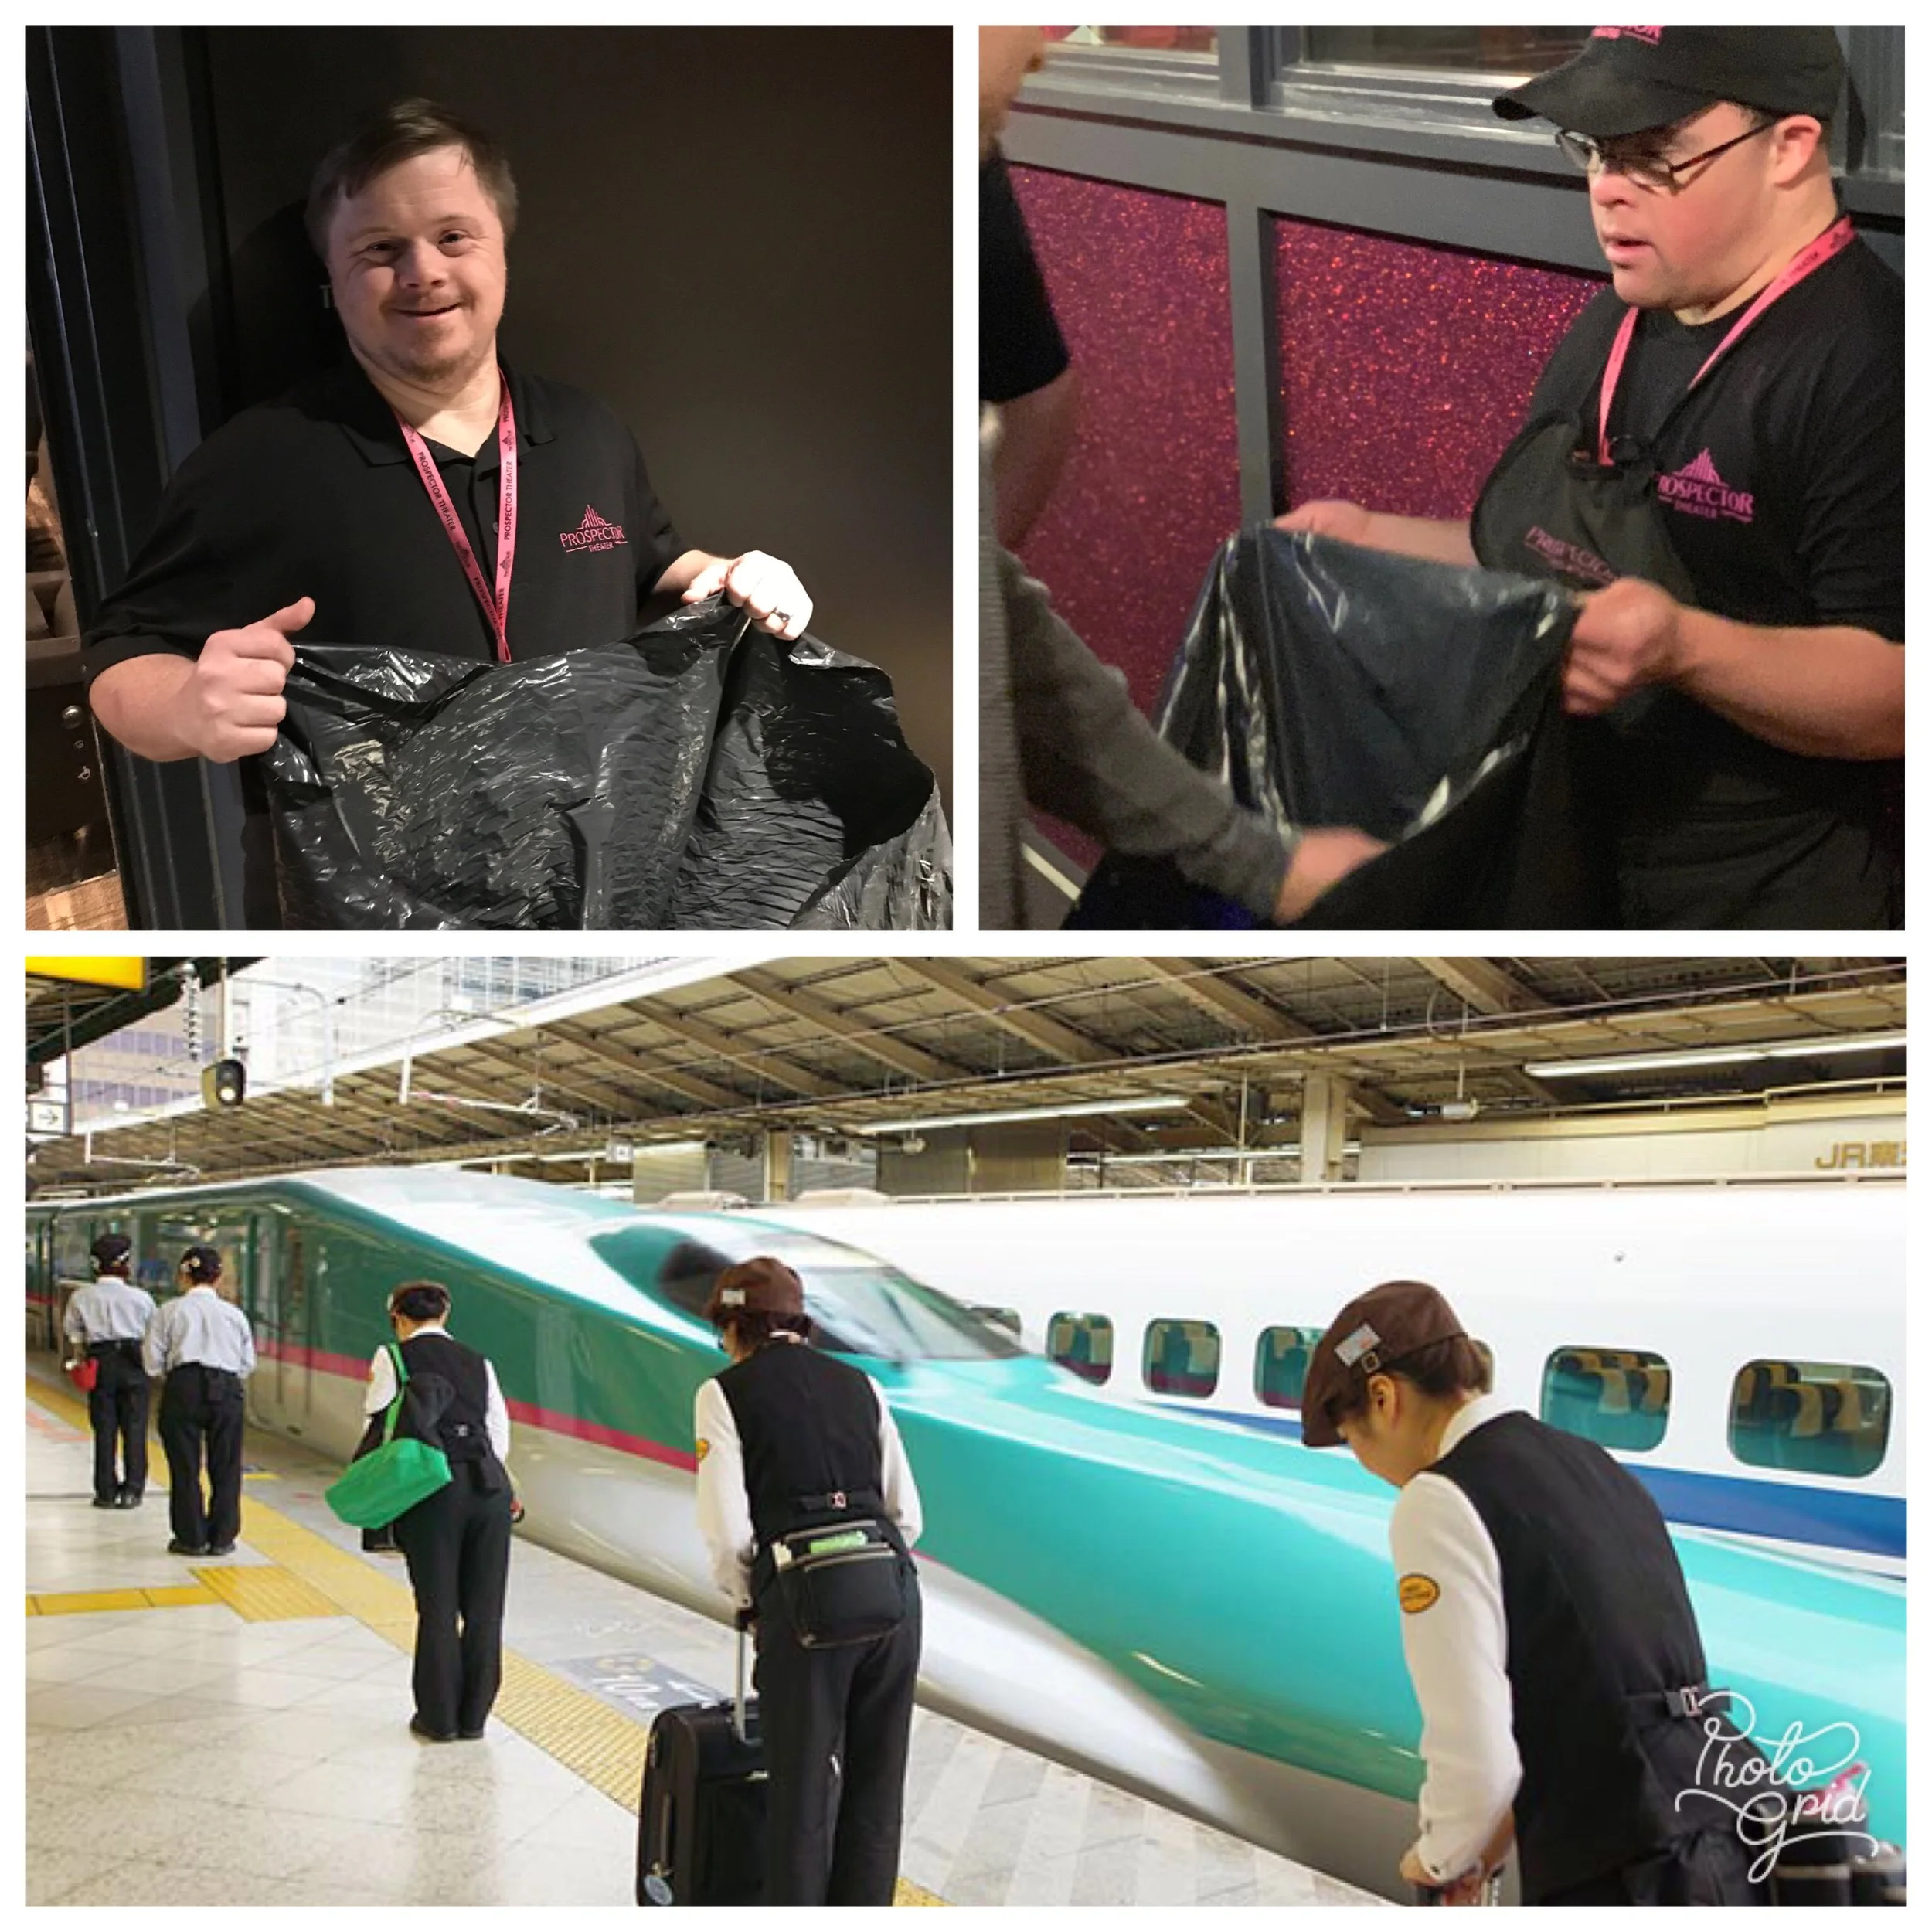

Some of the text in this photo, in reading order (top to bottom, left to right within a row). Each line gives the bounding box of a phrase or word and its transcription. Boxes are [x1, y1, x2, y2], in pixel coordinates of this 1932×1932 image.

[417, 451, 457, 532] PROSPECTOR THEATER
[504, 492, 513, 540] PROSPECTOR
[560, 525, 625, 547] PROSPECTOR
[588, 542, 615, 552] THEATER
